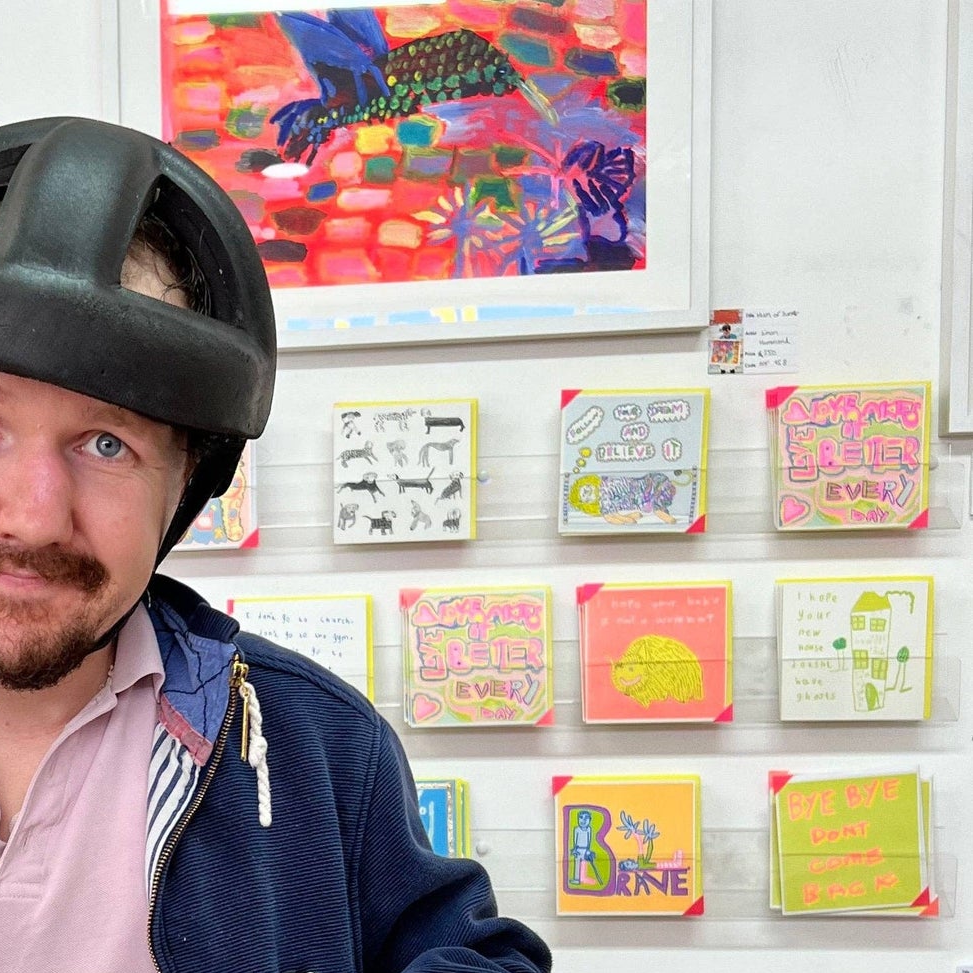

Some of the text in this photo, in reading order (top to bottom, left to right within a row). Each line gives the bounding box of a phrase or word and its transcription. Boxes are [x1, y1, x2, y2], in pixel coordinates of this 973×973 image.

[624, 425, 646, 438] AND
[665, 440, 681, 458] IT
[826, 473, 914, 508] EVERY
[850, 507, 890, 523] DAY
[456, 673, 540, 706] EVERY
[787, 777, 900, 822] BYE BYE
[810, 820, 870, 847] DONT
[808, 845, 885, 875] COME
[802, 871, 899, 907] BACK
